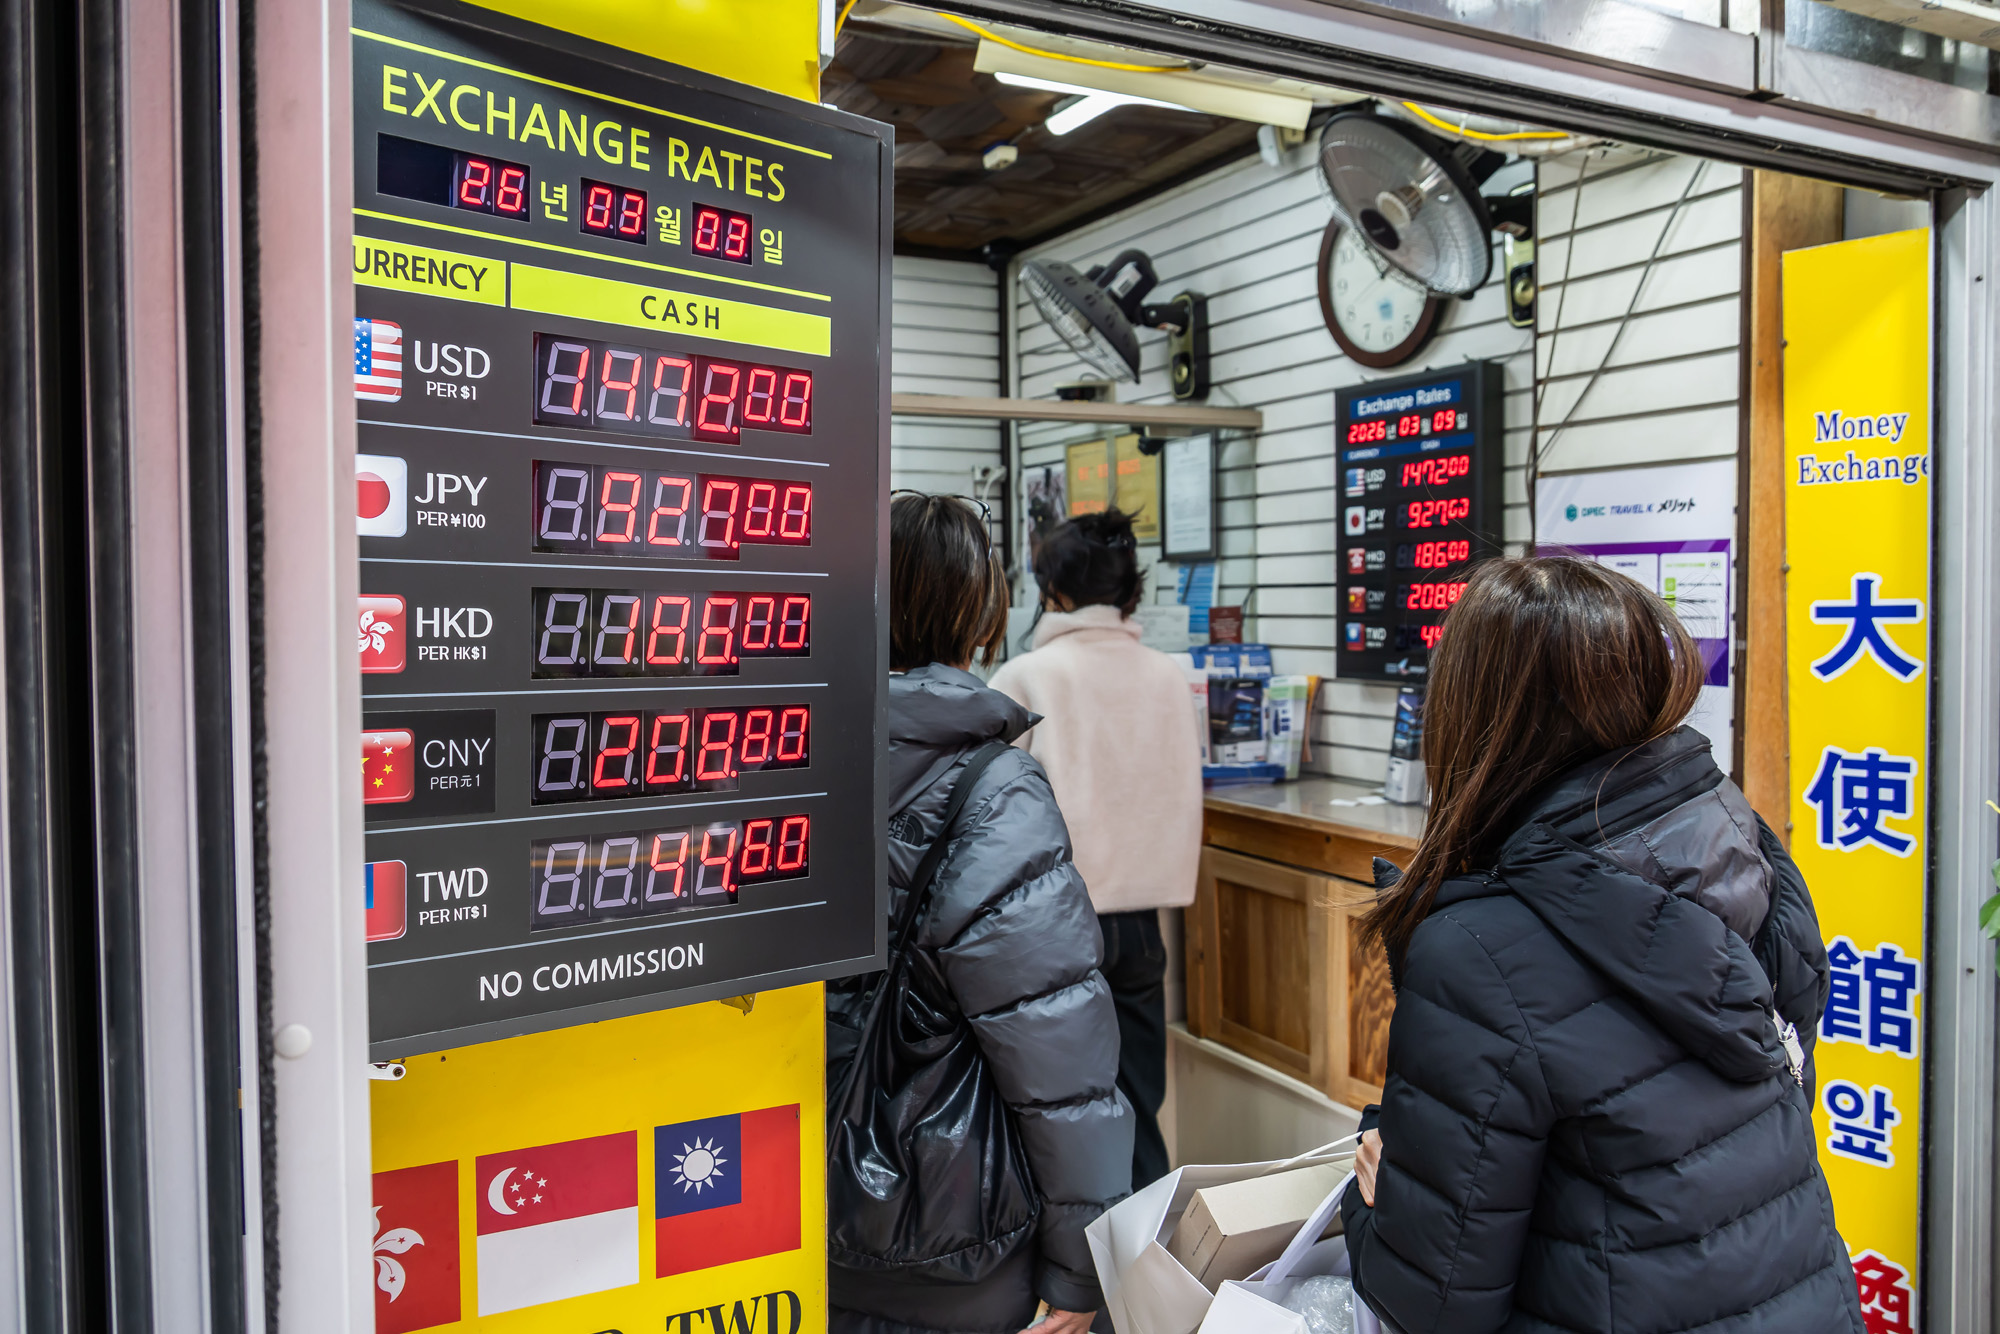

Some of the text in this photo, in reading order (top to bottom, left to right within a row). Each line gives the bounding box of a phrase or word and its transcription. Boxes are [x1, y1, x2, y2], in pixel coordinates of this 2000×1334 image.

[382, 64, 786, 203] EXCHANGE RATES
[461, 160, 525, 212] 26
[540, 181, 569, 222] 년
[586, 187, 644, 235] 03
[654, 205, 681, 246] 월
[759, 228, 783, 266] 일
[353, 245, 488, 292] URRENCY
[640, 295, 721, 331] CASH
[414, 340, 491, 379] USD
[426, 380, 477, 401] PER $1
[1357, 388, 1451, 416] Exchange Rates
[1348, 420, 1386, 444] 2026
[1398, 414, 1420, 436] 03
[1433, 409, 1456, 432] 09
[1815, 411, 1907, 442] Money
[414, 472, 488, 506] JPY
[416, 510, 486, 529] PER ¥100
[1367, 508, 1386, 522] JPY
[416, 607, 493, 638] HKD
[418, 645, 450, 661] PER
[423, 737, 491, 769] CNY
[430, 775, 459, 790] PER
[415, 867, 488, 903] TWD
[419, 908, 450, 926] PER
[479, 942, 704, 1001] NO COMMISSION
